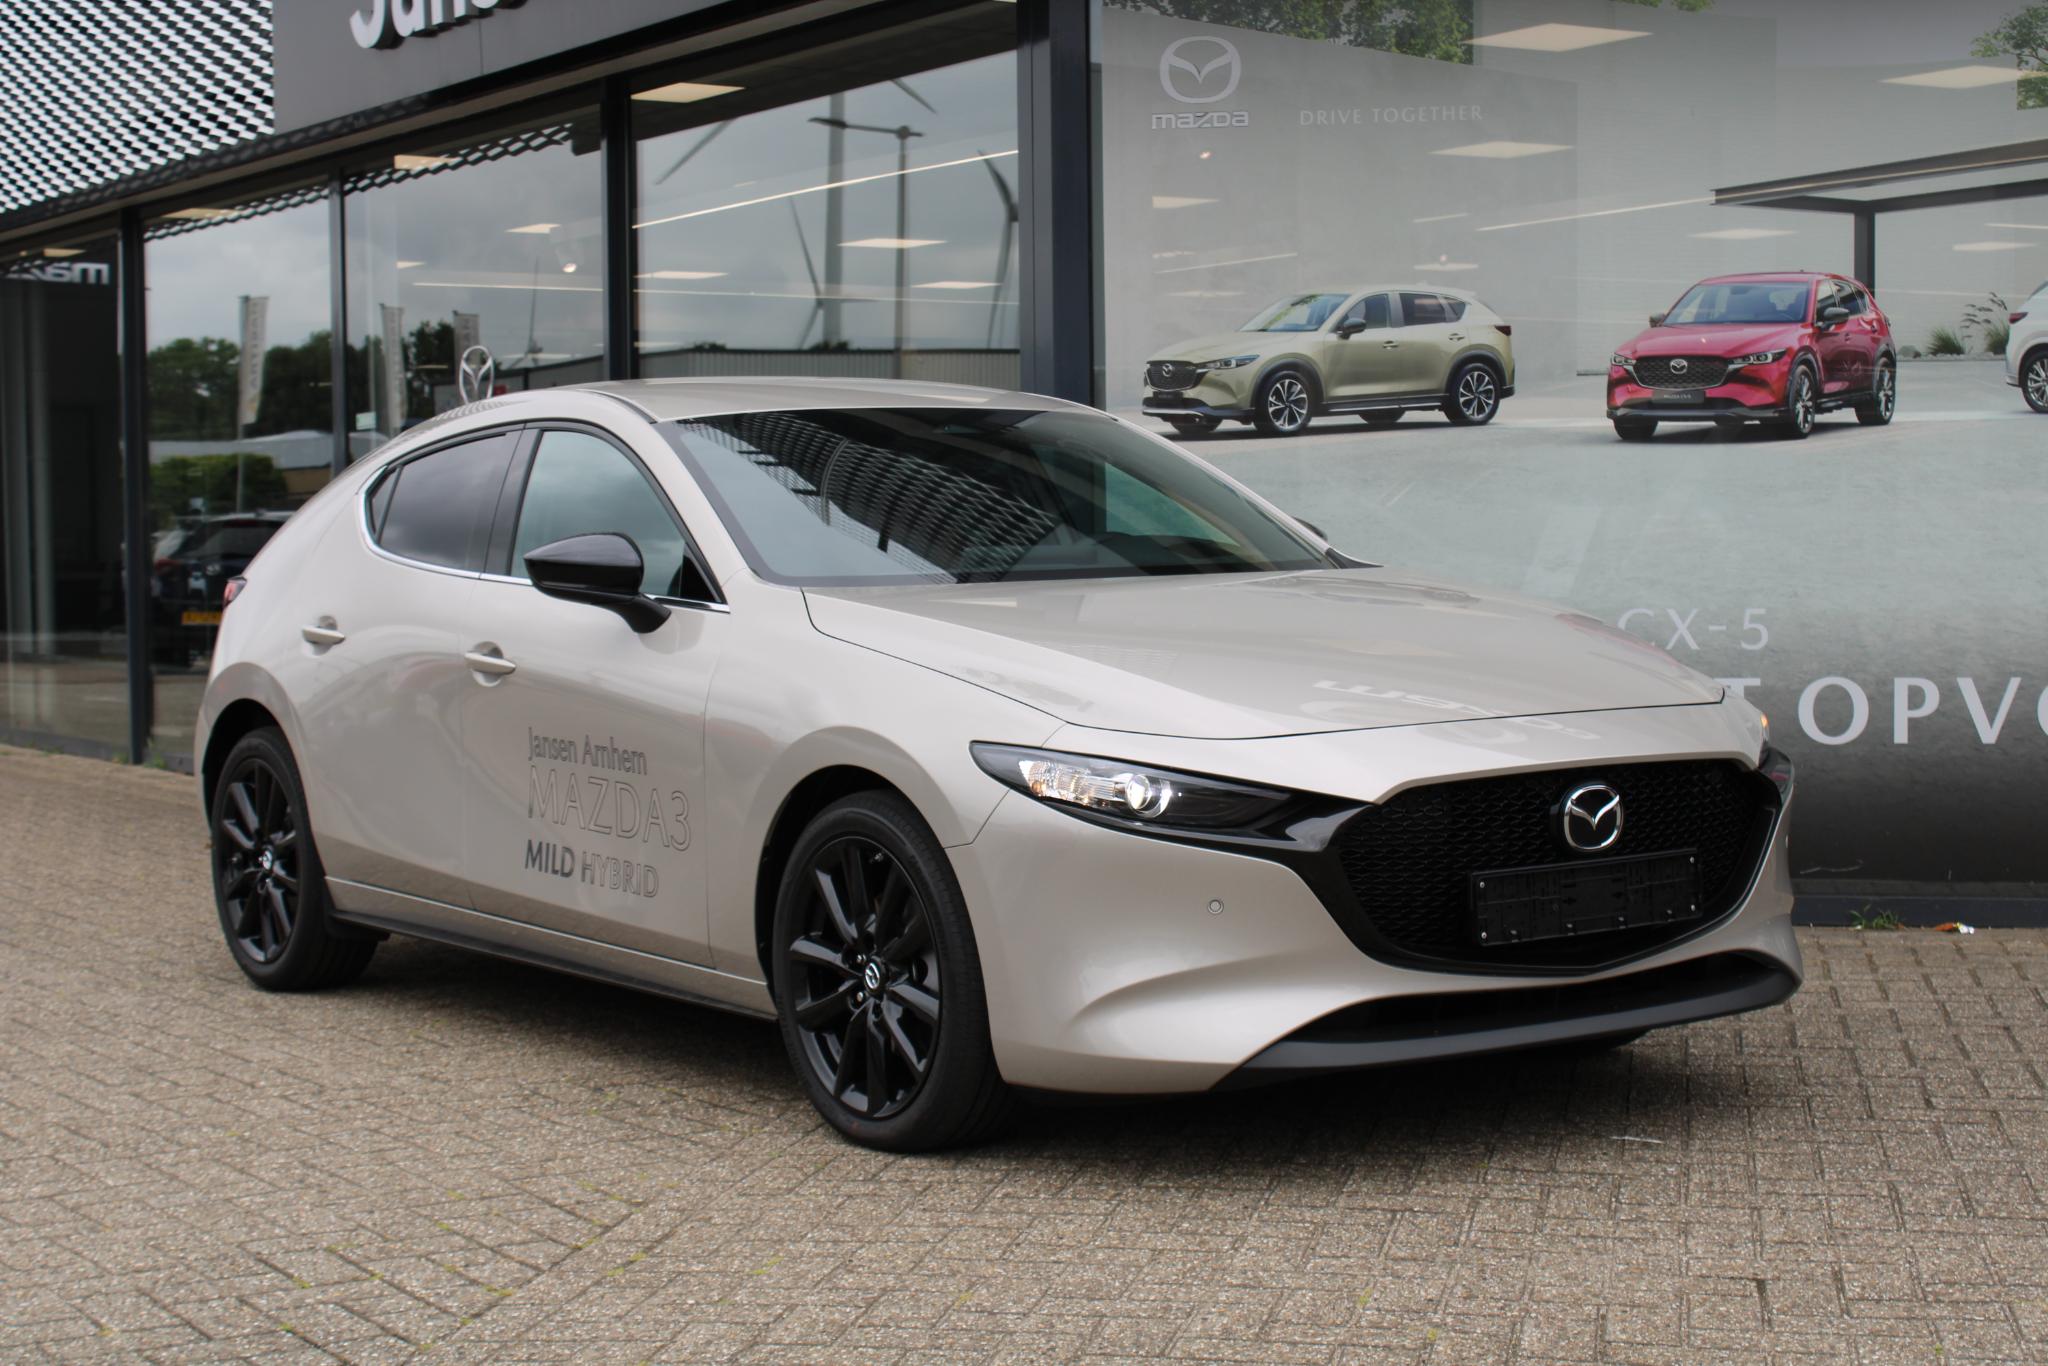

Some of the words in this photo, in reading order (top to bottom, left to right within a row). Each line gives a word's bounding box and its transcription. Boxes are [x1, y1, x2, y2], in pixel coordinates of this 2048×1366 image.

[349, 0, 499, 48] Ja
[1300, 108, 1361, 126] DRIVE
[1371, 104, 1484, 124] TOGETHER
[1798, 676, 2048, 745] OPV
[528, 726, 578, 763] Jansen
[582, 734, 648, 776] Arnhem
[528, 764, 691, 852] MAZDA3
[525, 839, 575, 878] MILD
[580, 851, 659, 898] HYBRID
